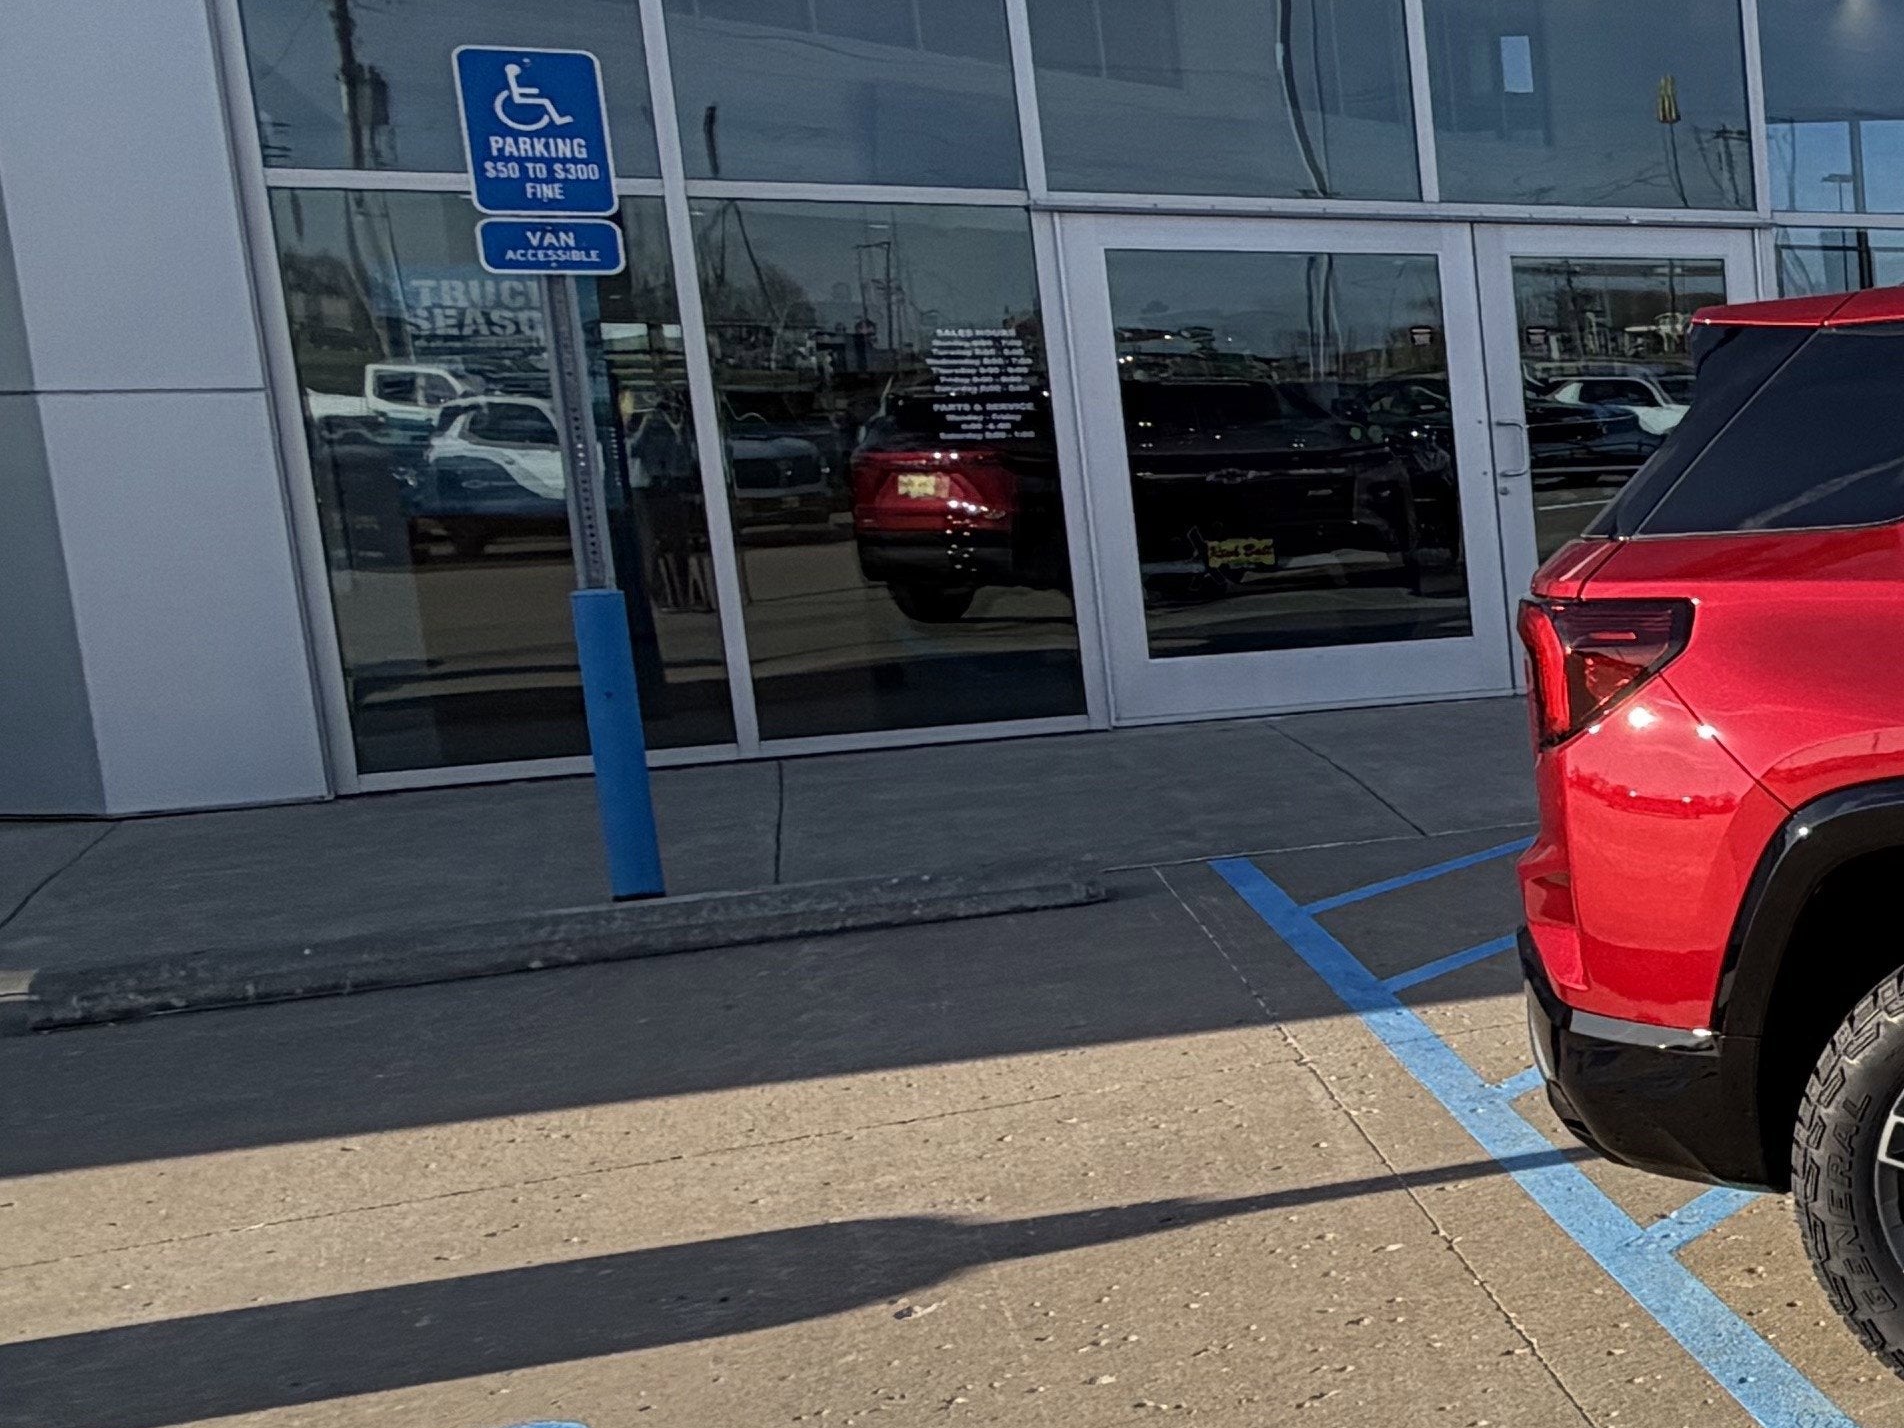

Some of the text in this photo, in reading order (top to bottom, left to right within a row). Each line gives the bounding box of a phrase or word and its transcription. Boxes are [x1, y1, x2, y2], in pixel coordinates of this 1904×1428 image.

[489, 136, 588, 160] PARKING
[484, 161, 600, 181] $50 TO $300
[525, 183, 565, 200] FINE
[526, 231, 575, 247] VAN
[505, 250, 601, 262] ACCESSIBLE
[406, 307, 544, 335] SEASO
[1827, 1093, 1898, 1314] GENERAL
